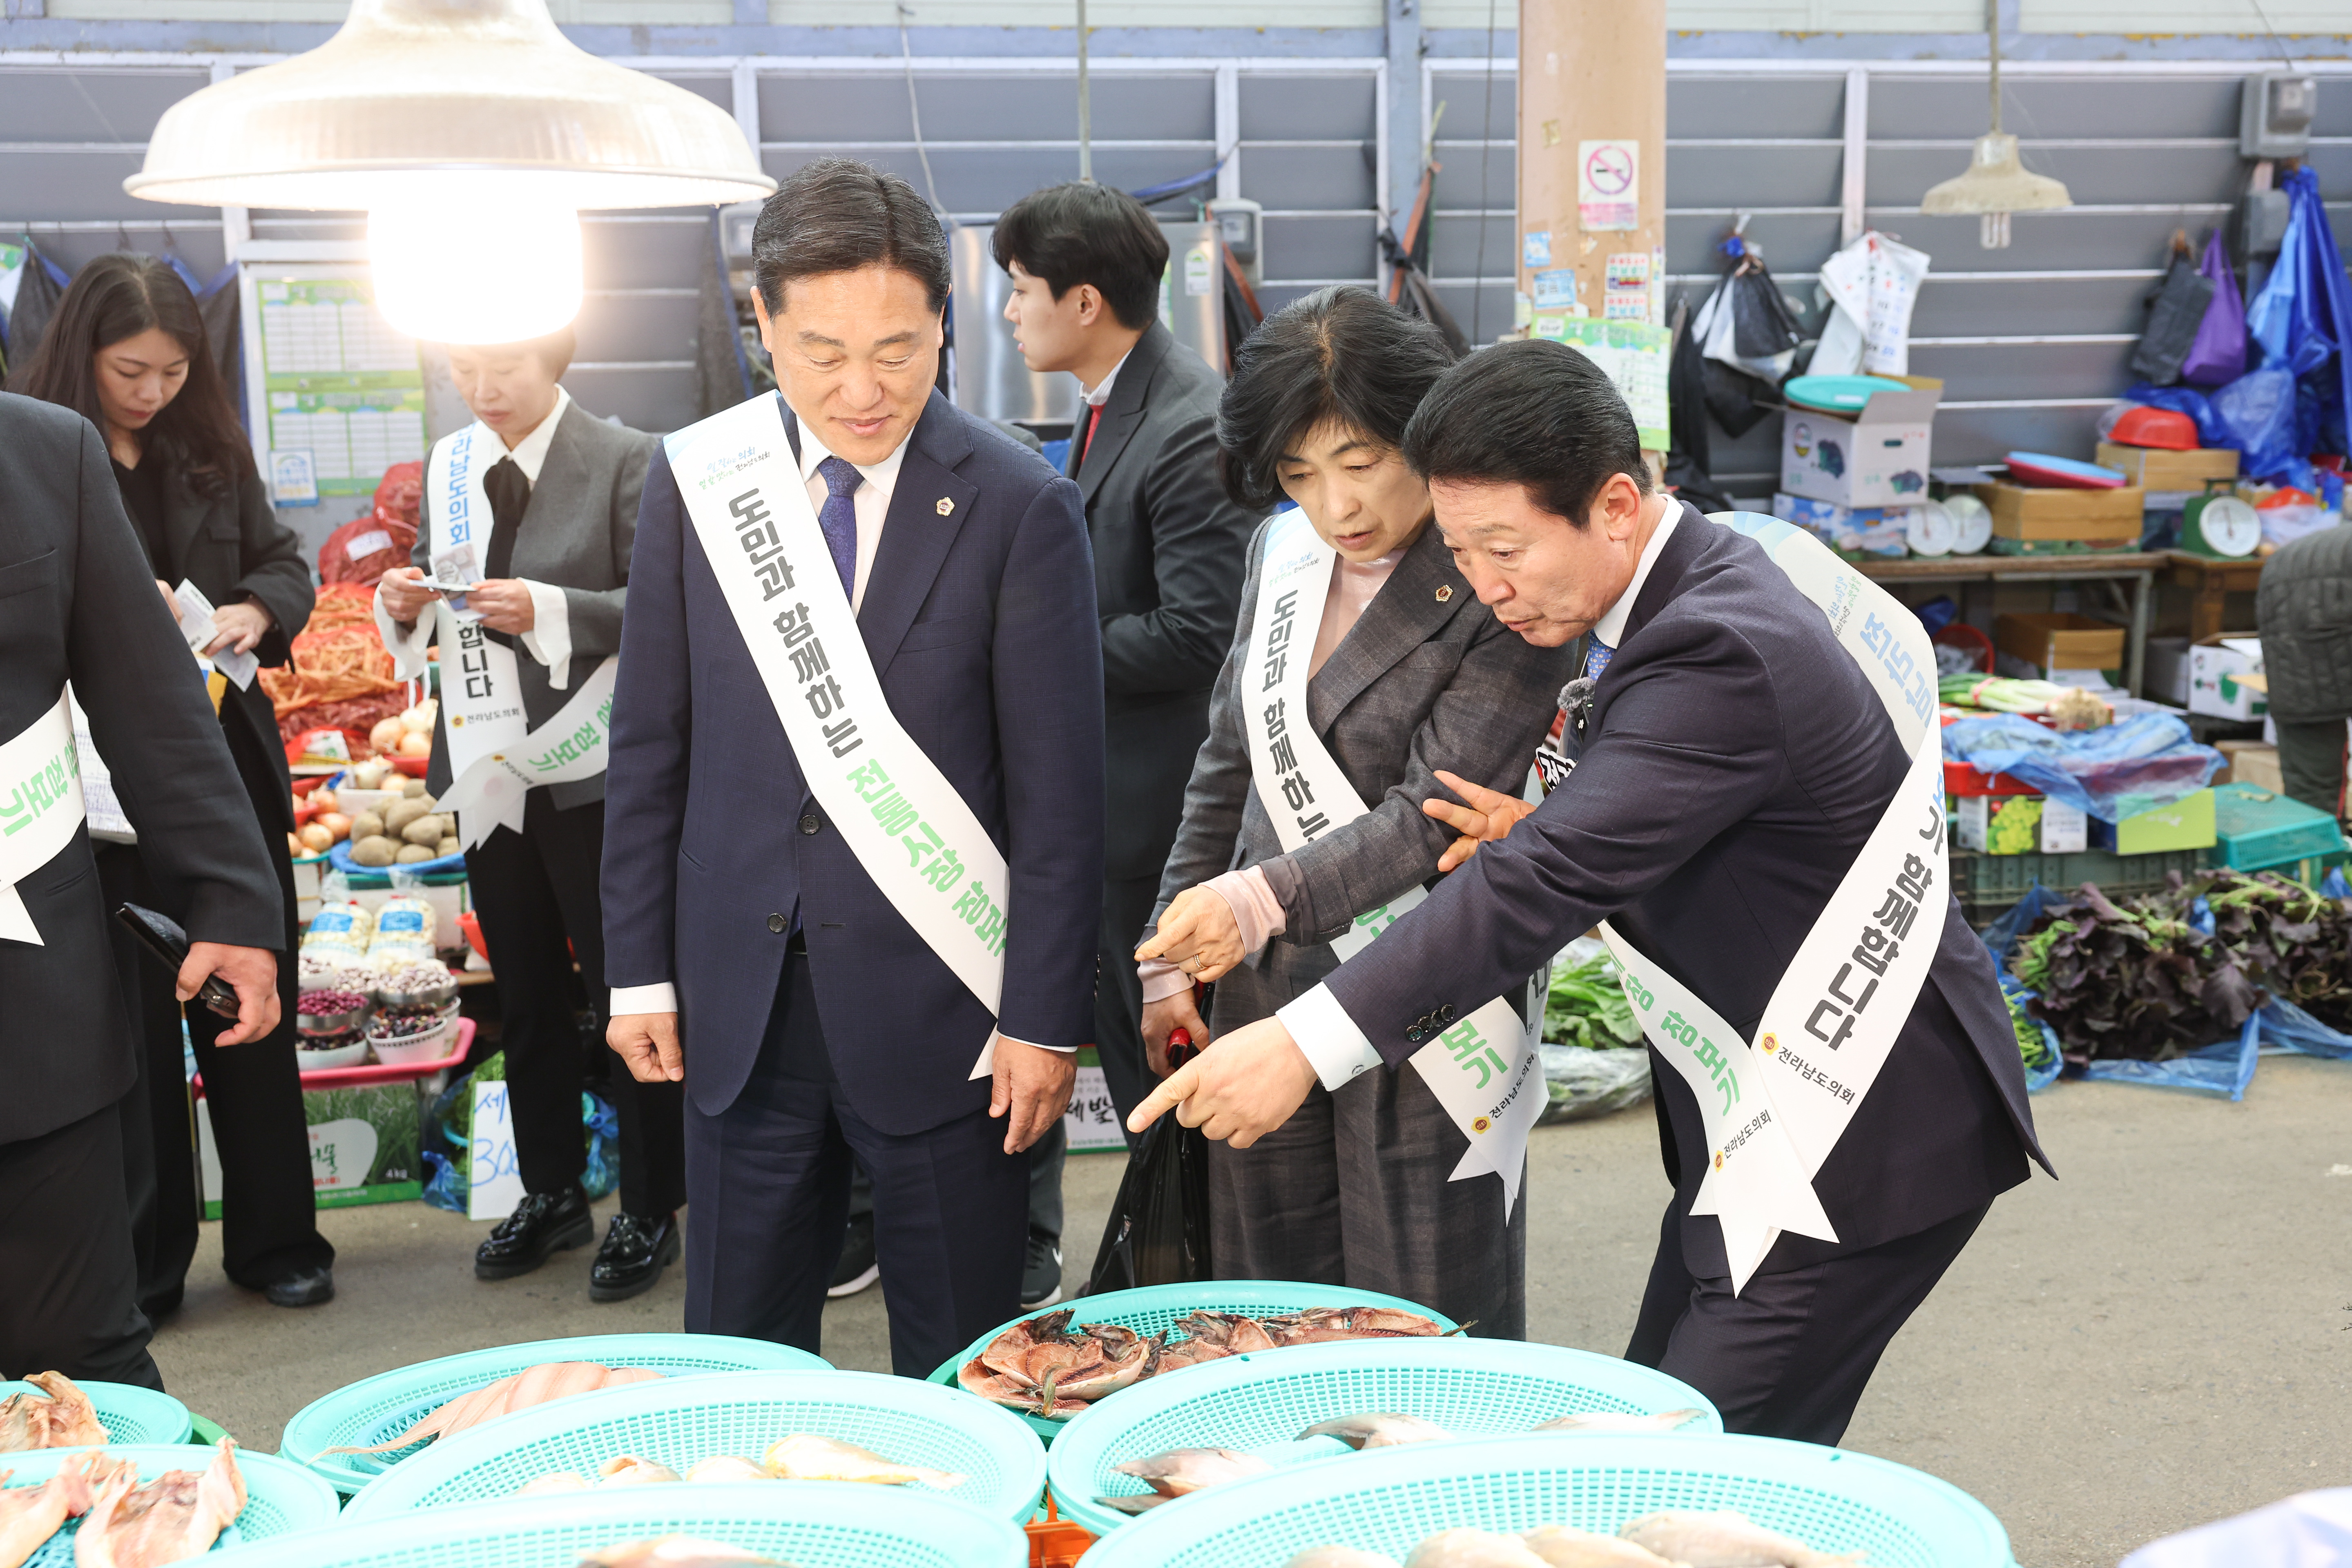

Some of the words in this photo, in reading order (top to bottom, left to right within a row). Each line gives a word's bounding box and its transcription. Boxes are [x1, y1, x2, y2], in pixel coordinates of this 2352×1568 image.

[707, 462, 720, 473] 일
[739, 446, 755, 460] 의회
[735, 451, 770, 472] 전라남도의회
[457, 620, 493, 699] 합니다
[528, 721, 601, 772] 장보기
[729, 488, 796, 602] 도민과
[773, 602, 864, 759] 함께하는
[846, 758, 965, 892] 전통시장
[951, 881, 1008, 957] 장보
[0, 754, 68, 837] 장보기
[1919, 758, 1947, 856] 회가
[1262, 589, 1299, 693] 도민과
[1439, 1019, 1508, 1089] 보기
[1804, 852, 1932, 1051] 함께합니다
[1489, 1053, 1535, 1119] 전라남도의회
[1660, 1010, 1740, 1117] 장보기
[1779, 1046, 1856, 1105] 전라남도의회
[1724, 1109, 1772, 1159] 전라남도의회
